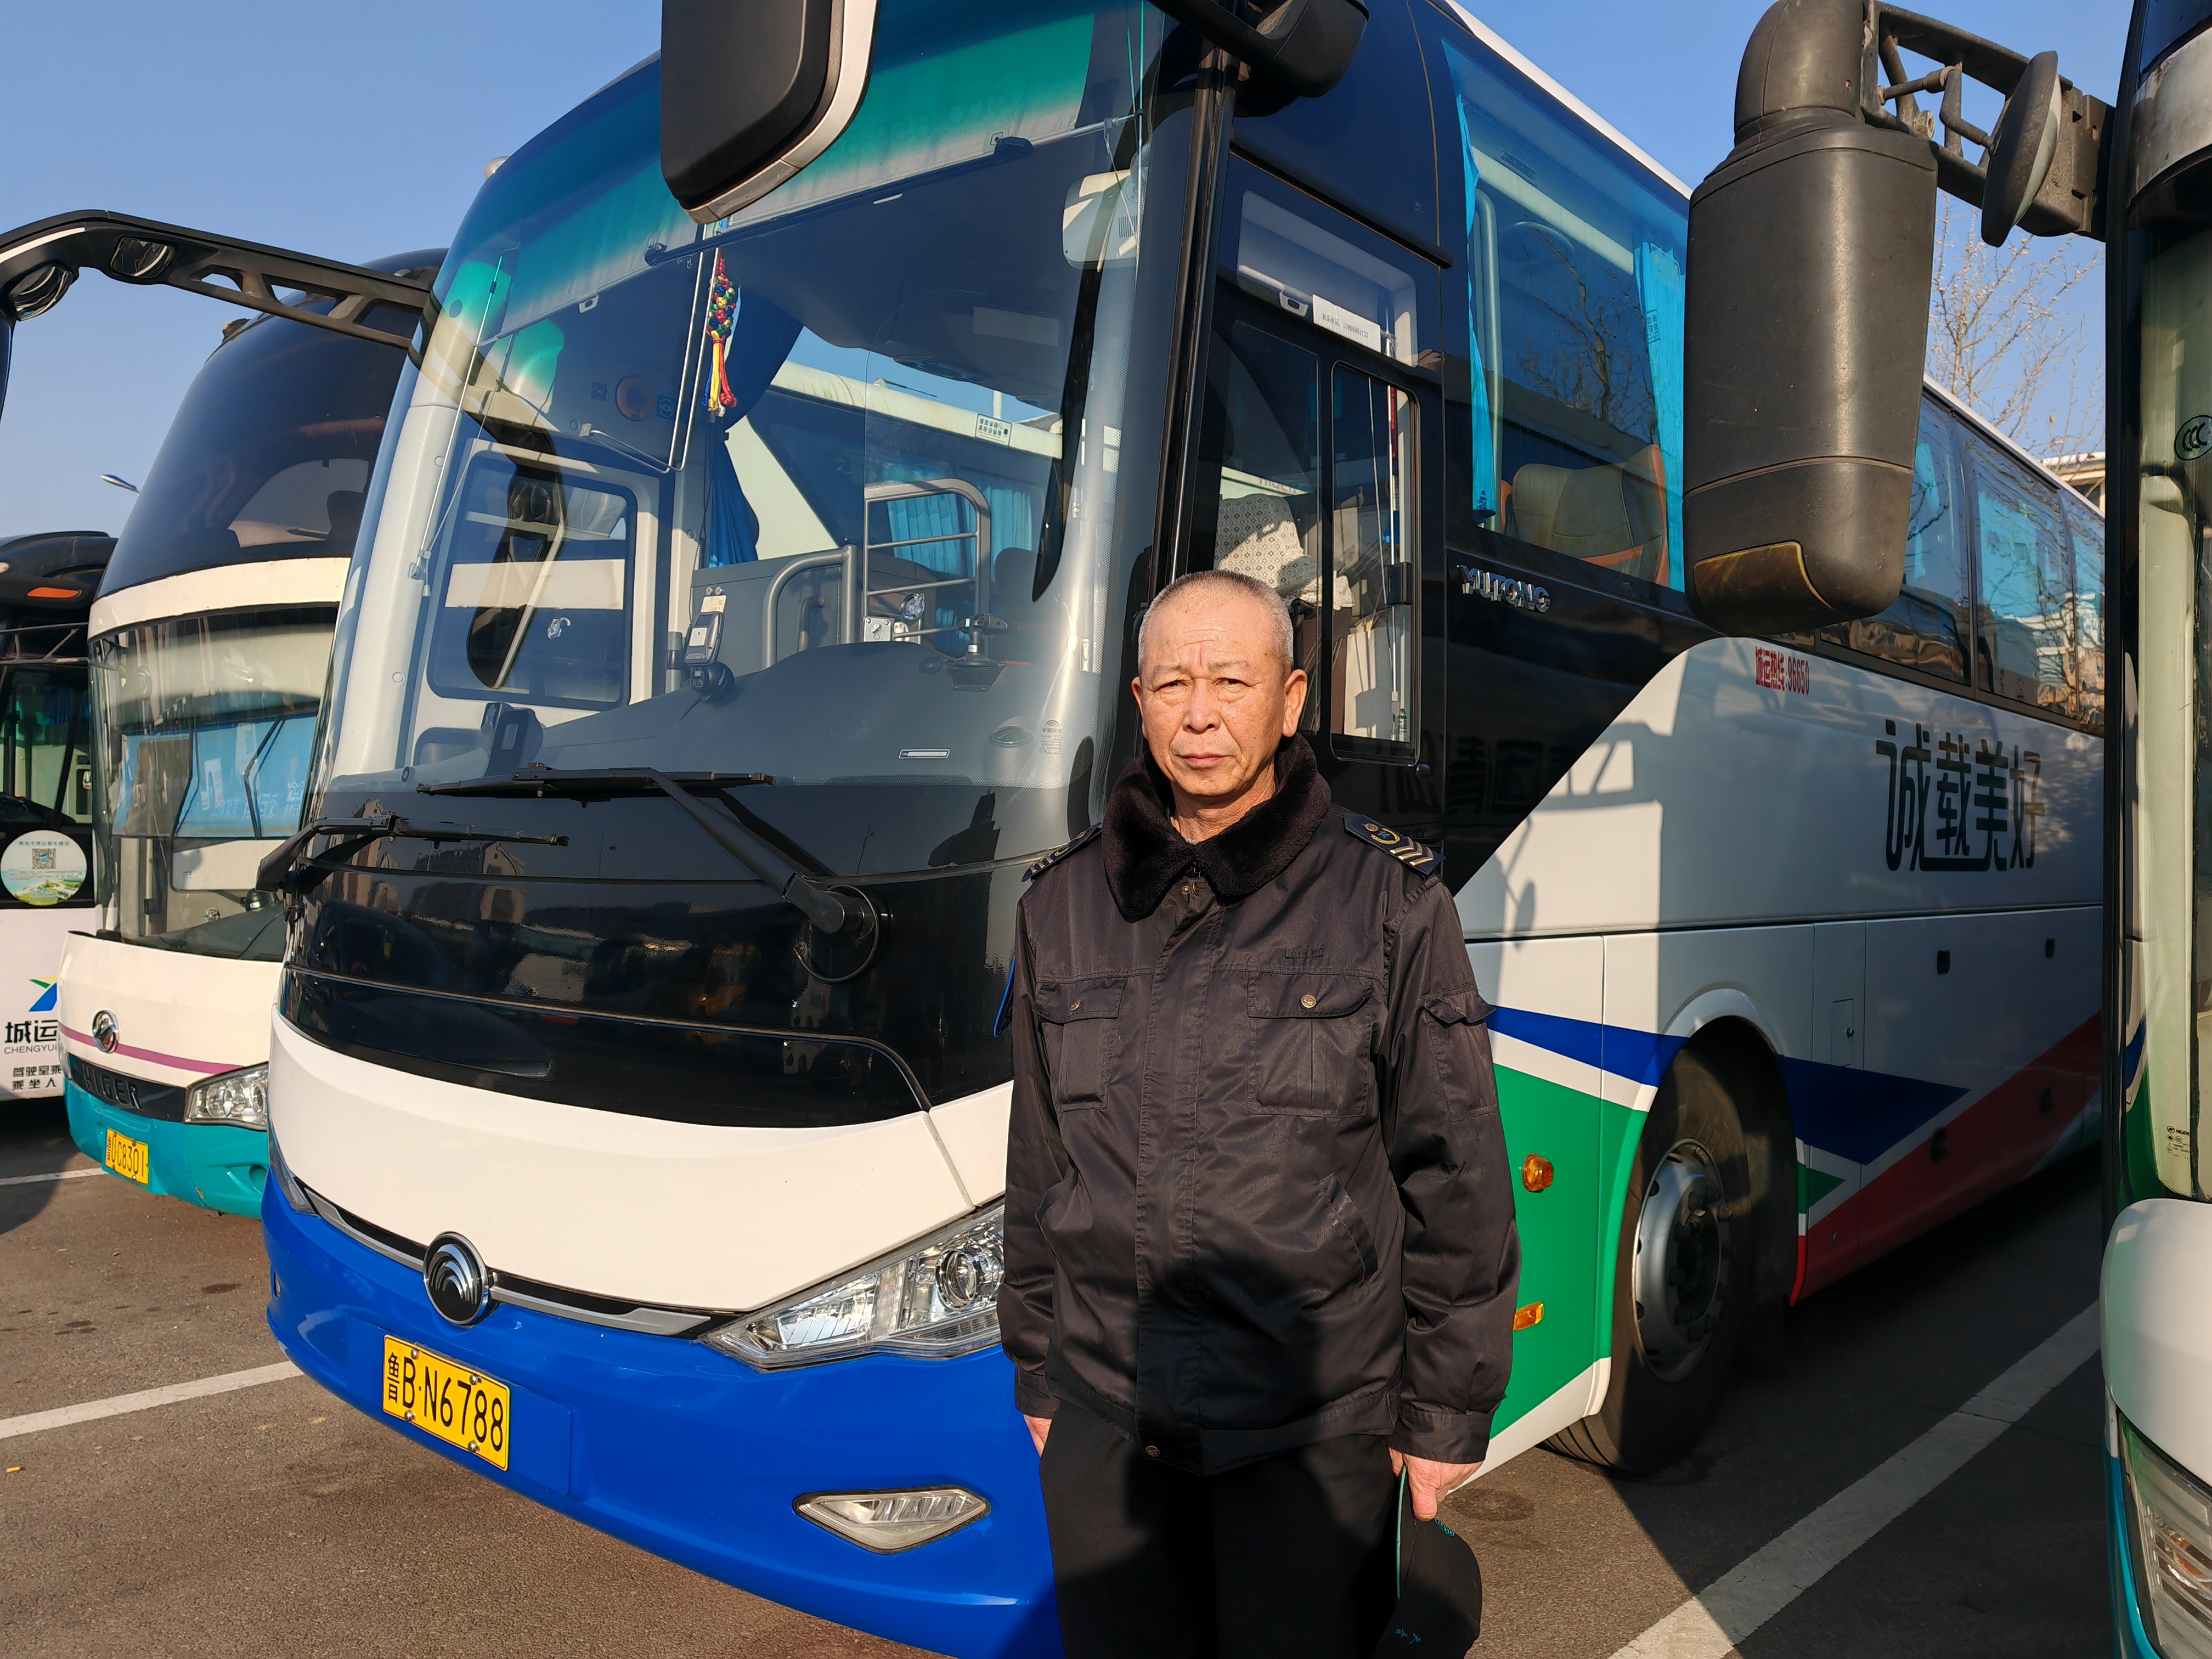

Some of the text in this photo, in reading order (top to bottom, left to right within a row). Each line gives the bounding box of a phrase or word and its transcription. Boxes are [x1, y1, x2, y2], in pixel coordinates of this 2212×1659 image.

[1457, 565, 1551, 613] YUTONG
[1876, 719, 2045, 871] 诚载美好
[4, 1019, 58, 1043] 城运
[83, 1064, 143, 1111] HIGER
[387, 1352, 504, 1452] 鲁B·N6788
